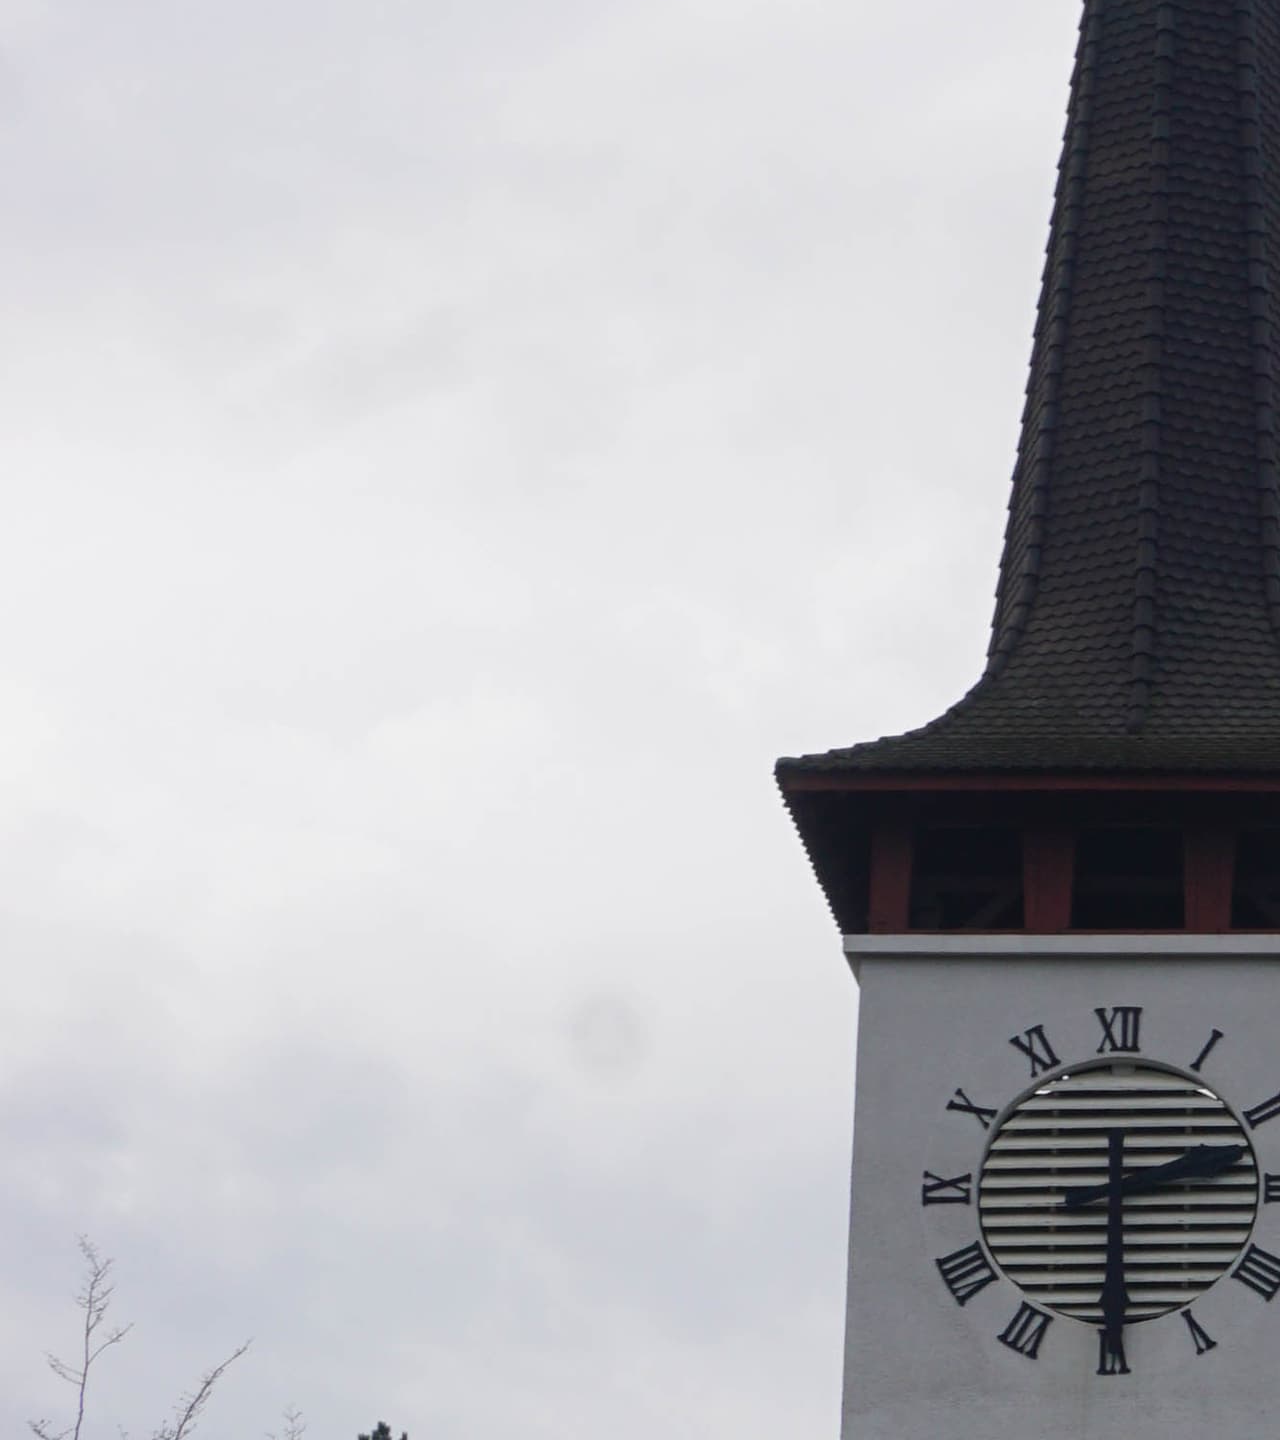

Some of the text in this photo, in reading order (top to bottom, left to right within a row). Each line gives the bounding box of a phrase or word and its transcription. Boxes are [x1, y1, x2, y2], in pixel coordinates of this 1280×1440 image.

[1009, 1024, 1062, 1078] XI
[1094, 1006, 1142, 1053] XII
[1190, 1029, 1223, 1072] I
[946, 1088, 998, 1130] X
[922, 1171, 971, 1206] IX
[935, 1240, 999, 1306] VIII
[997, 1300, 1054, 1359] VII
[1181, 1308, 1217, 1355] V
